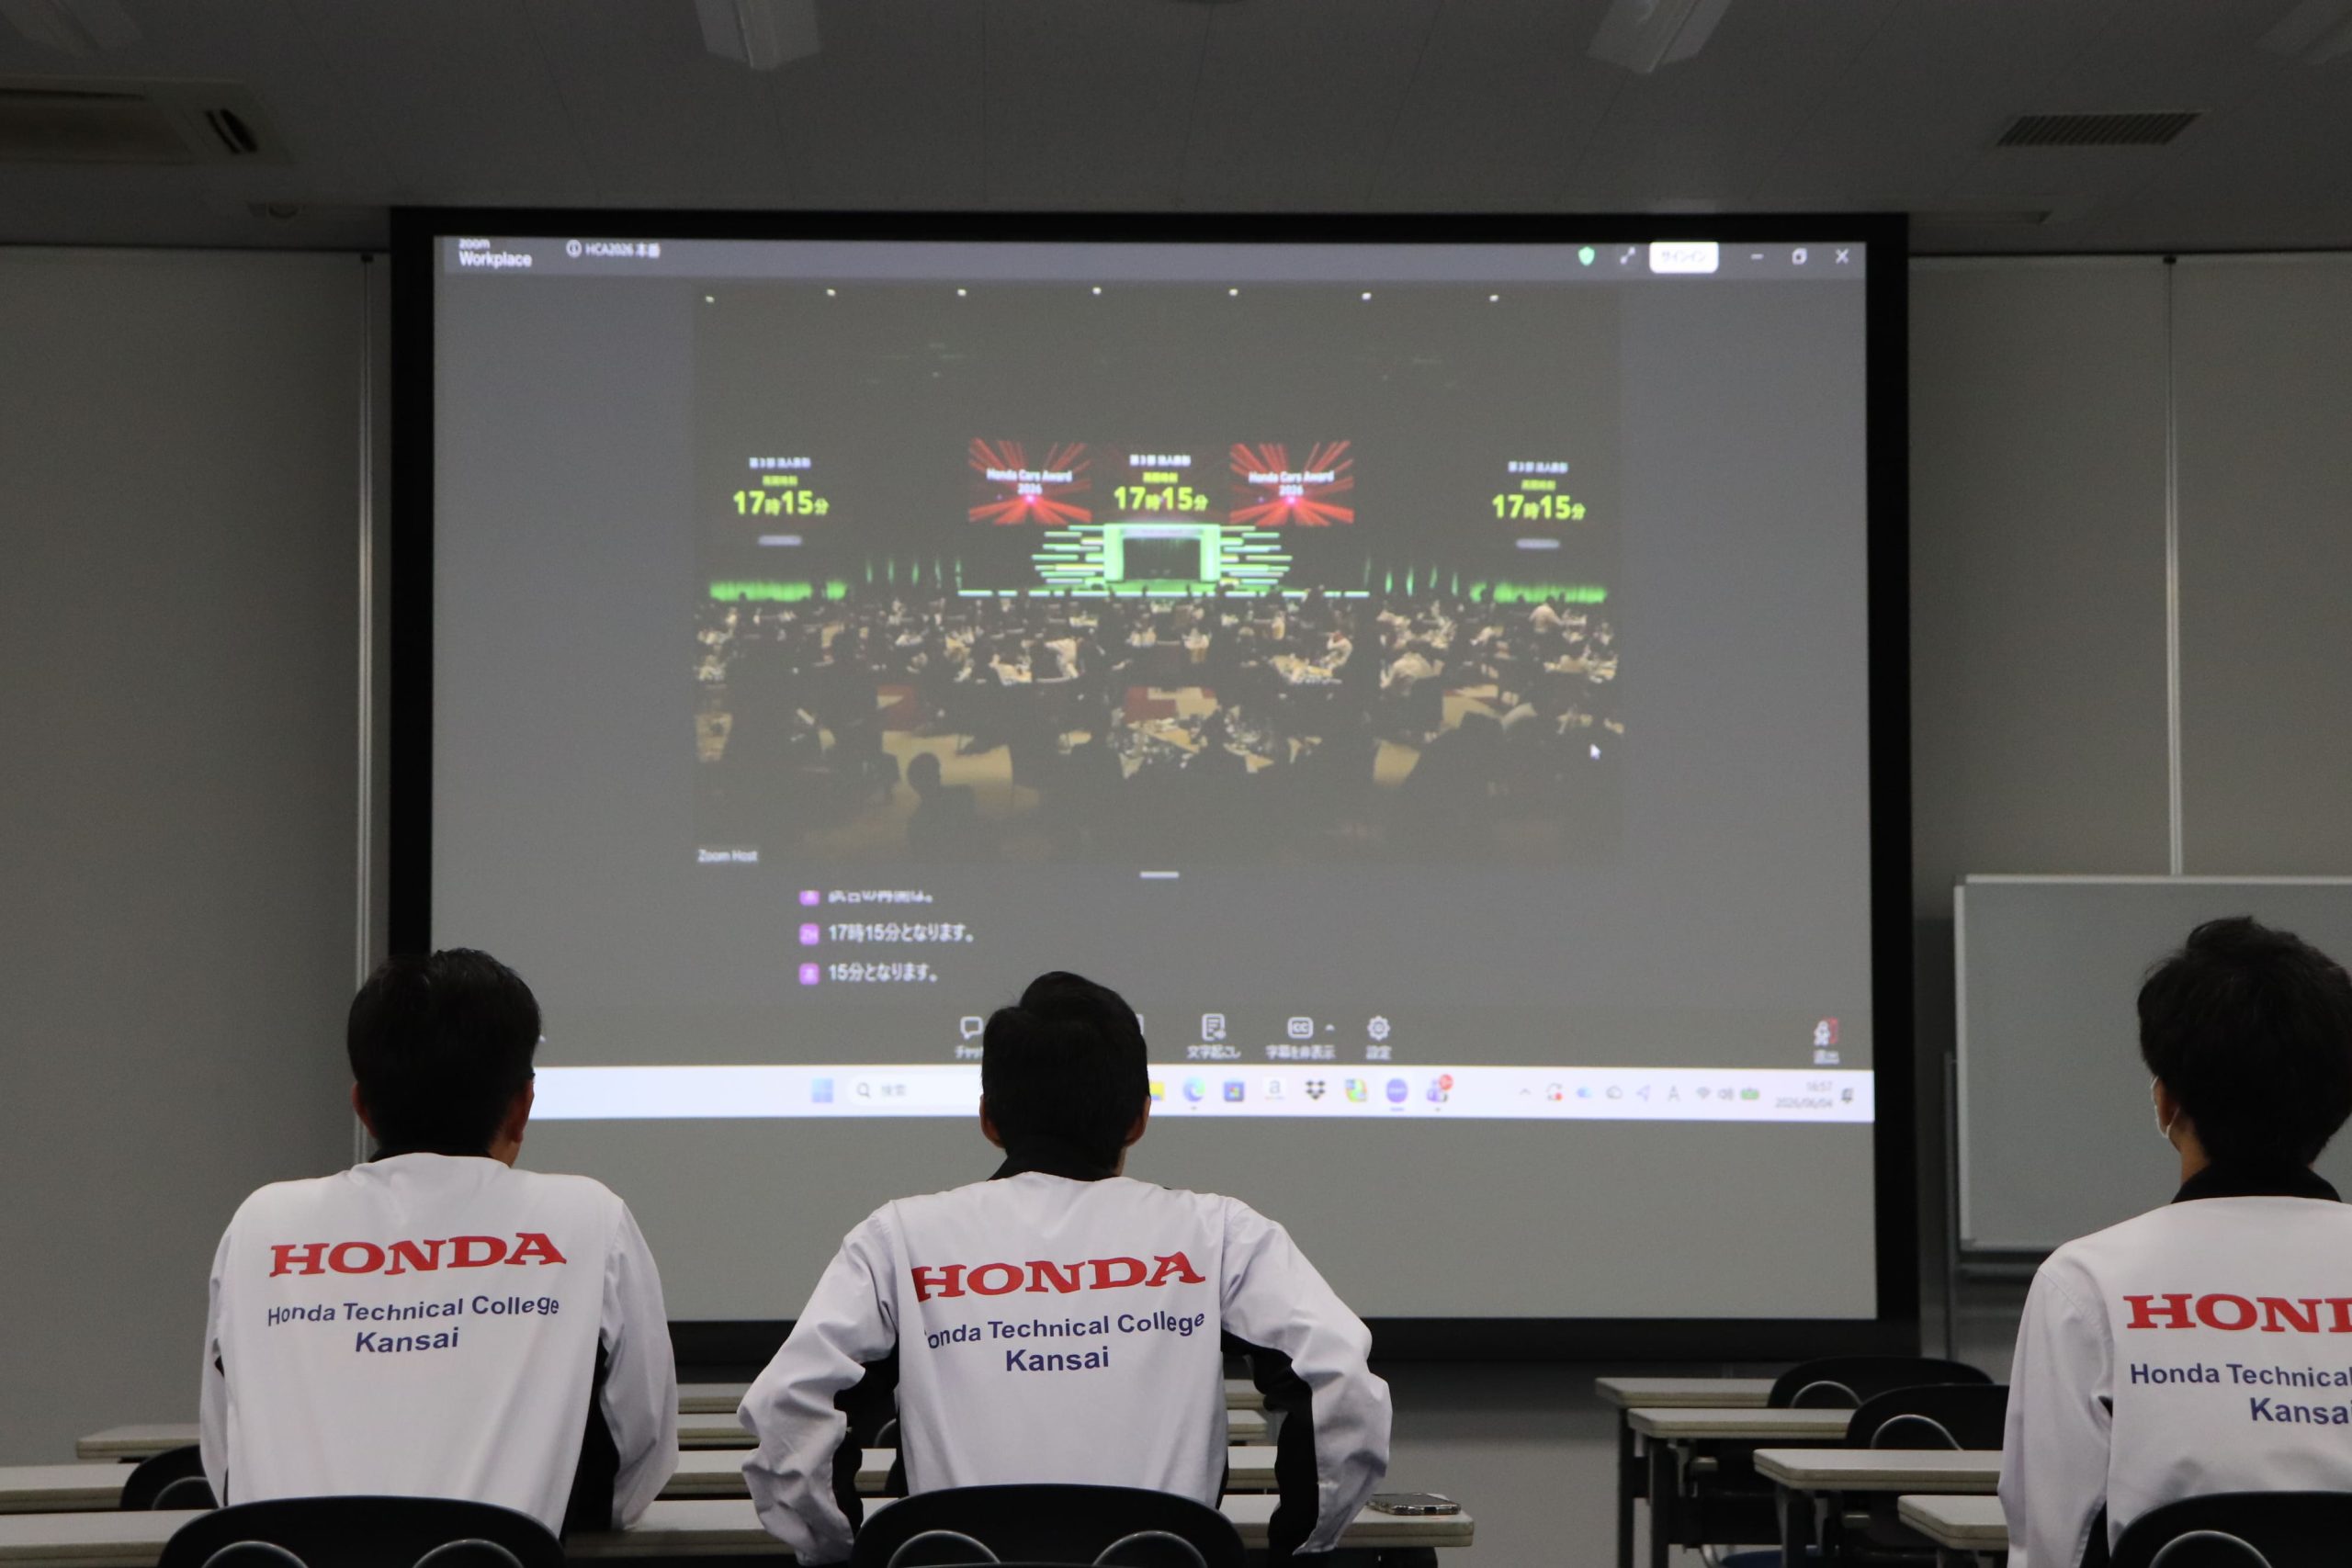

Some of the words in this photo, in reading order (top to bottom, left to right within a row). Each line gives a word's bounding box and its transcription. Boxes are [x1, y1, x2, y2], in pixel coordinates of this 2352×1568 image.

[459, 239, 491, 250] zoom
[459, 252, 533, 269] Workplace
[733, 490, 830, 516] 17時15分
[1114, 486, 1209, 512] 17時15分
[1492, 493, 1587, 520] 17時15分
[697, 849, 731, 863] Zoom
[732, 850, 758, 863] Host
[828, 923, 974, 943] 17時15分となります。
[828, 963, 938, 983] 15分となります。
[269, 1232, 567, 1278] HONDA
[910, 1250, 1206, 1303] HONDA
[267, 1303, 335, 1326] Honda
[343, 1298, 464, 1322] Technical
[471, 1295, 560, 1315] College
[355, 1326, 459, 1353] Kansai
[924, 1323, 982, 1349] onda
[987, 1315, 1110, 1339] Technical
[1117, 1310, 1205, 1337] College
[1005, 1346, 1110, 1372] Kansai
[2130, 1362, 2221, 1385] Honda
